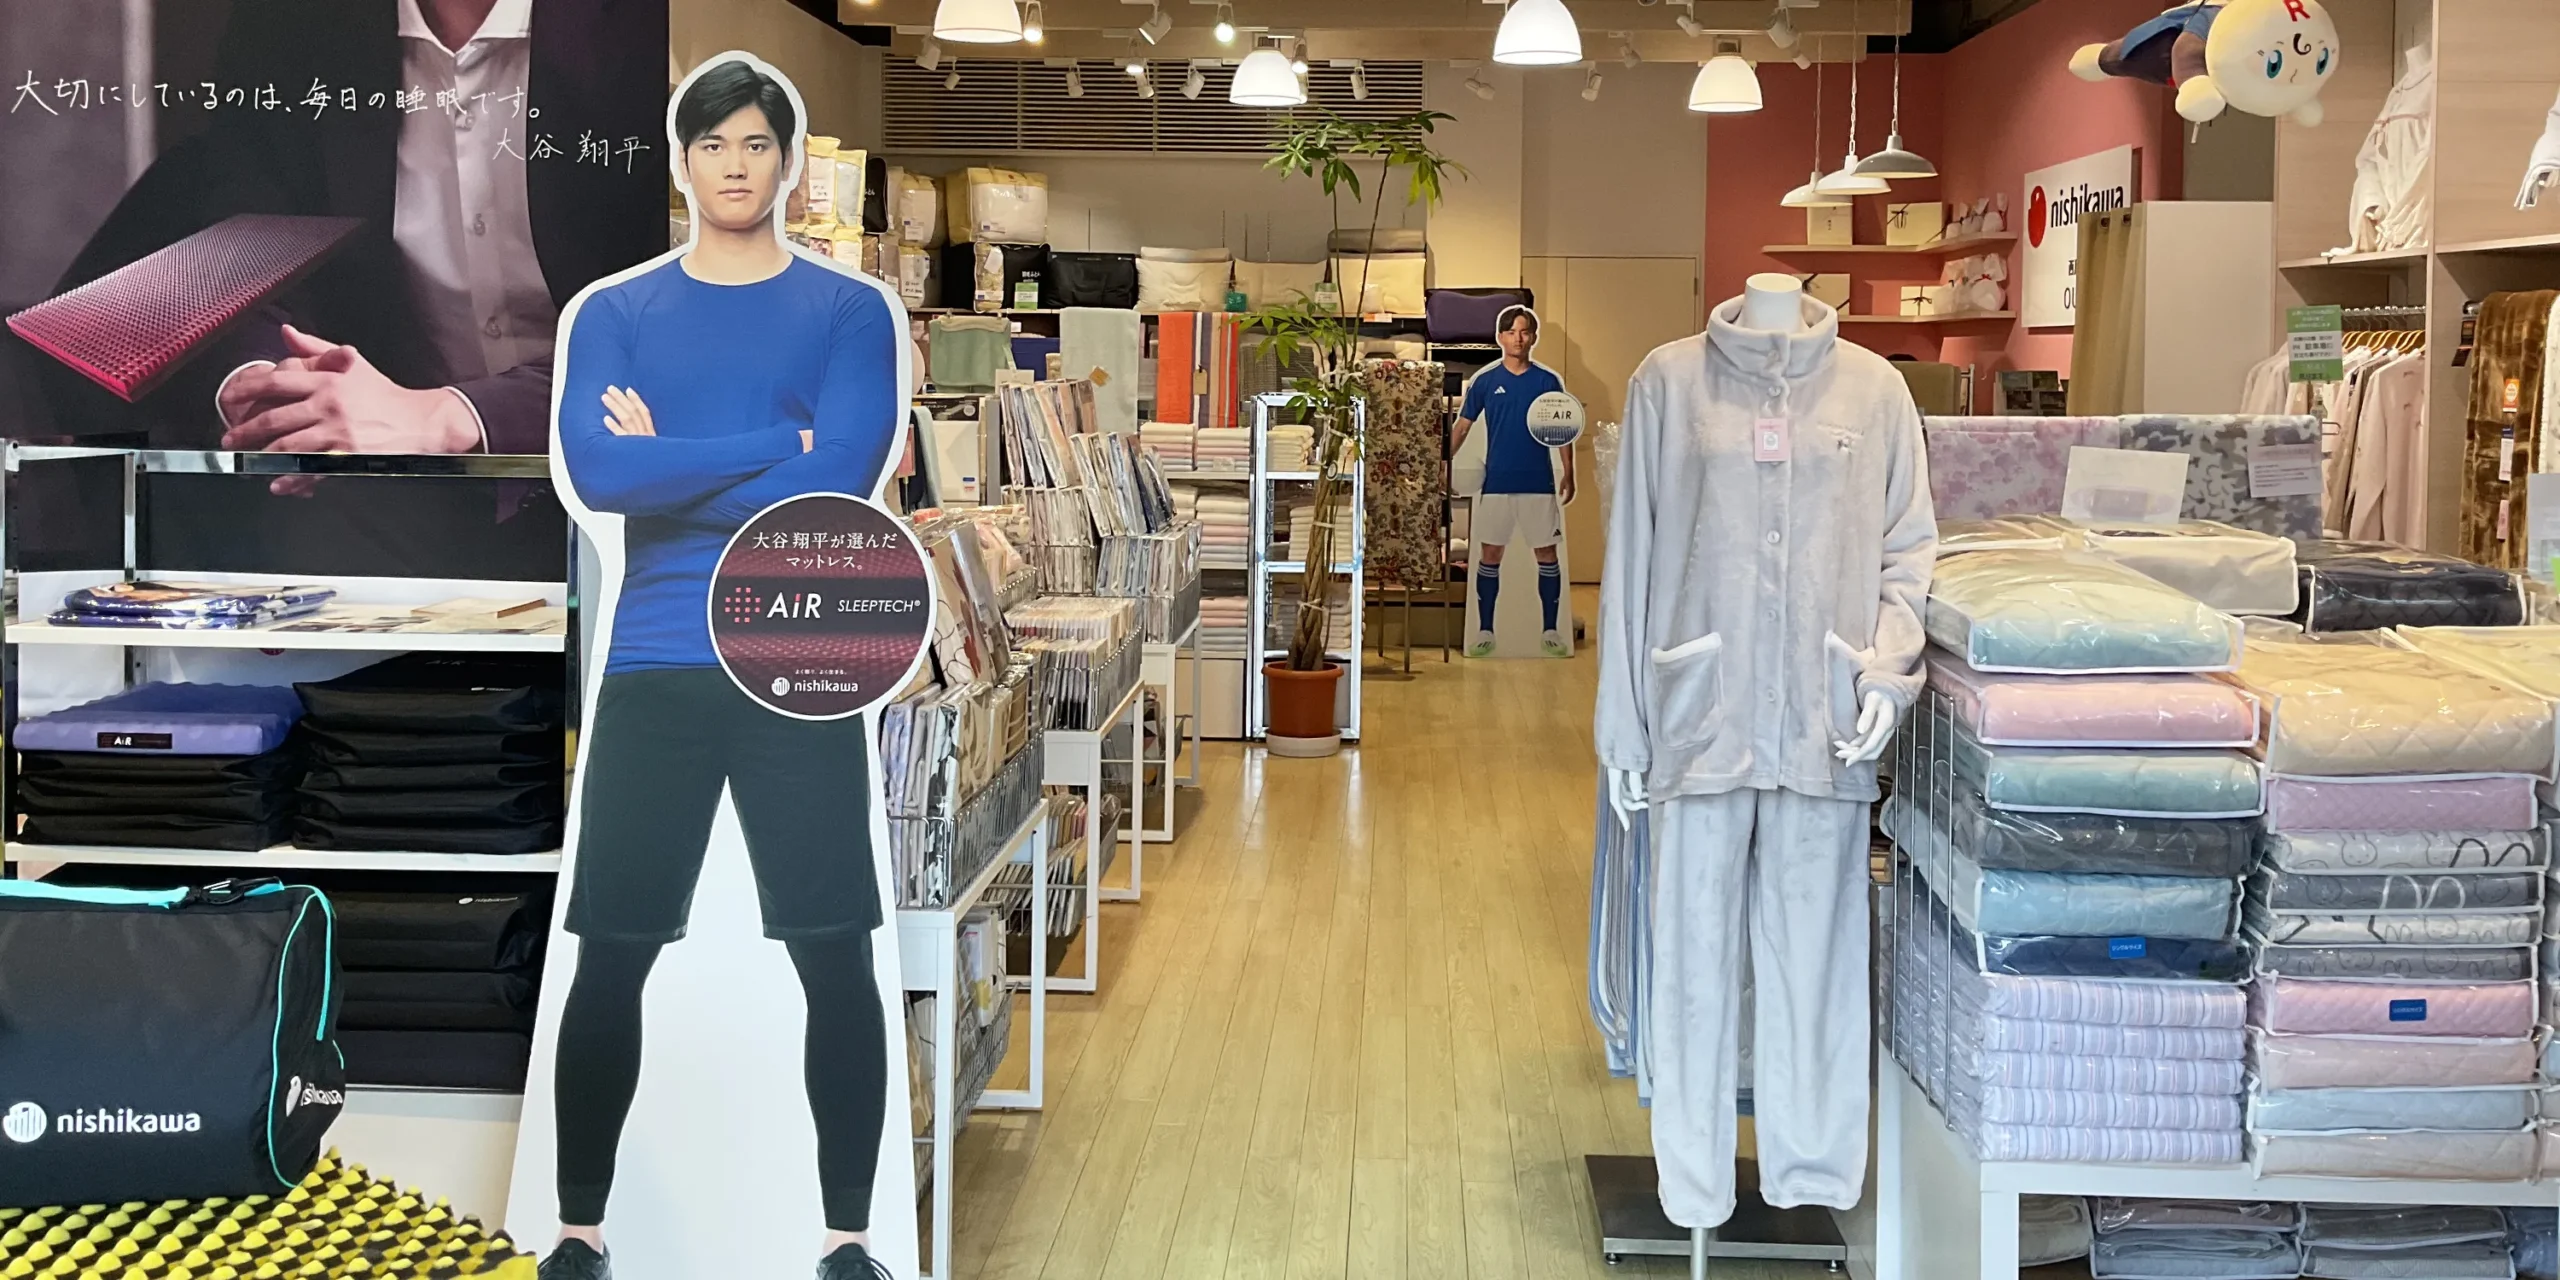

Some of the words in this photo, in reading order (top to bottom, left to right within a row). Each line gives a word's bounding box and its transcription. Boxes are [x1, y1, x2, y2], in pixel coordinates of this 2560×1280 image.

[2283, 0, 2310, 22] R
[10, 69, 541, 120] 大切にしているのは、毎日の睡眠です。
[492, 128, 564, 161] 大谷
[577, 131, 651, 173] 翔平
[786, 555, 863, 570] マットレス。
[794, 679, 859, 692] nishikawa
[57, 1107, 201, 1133] nishikawa
